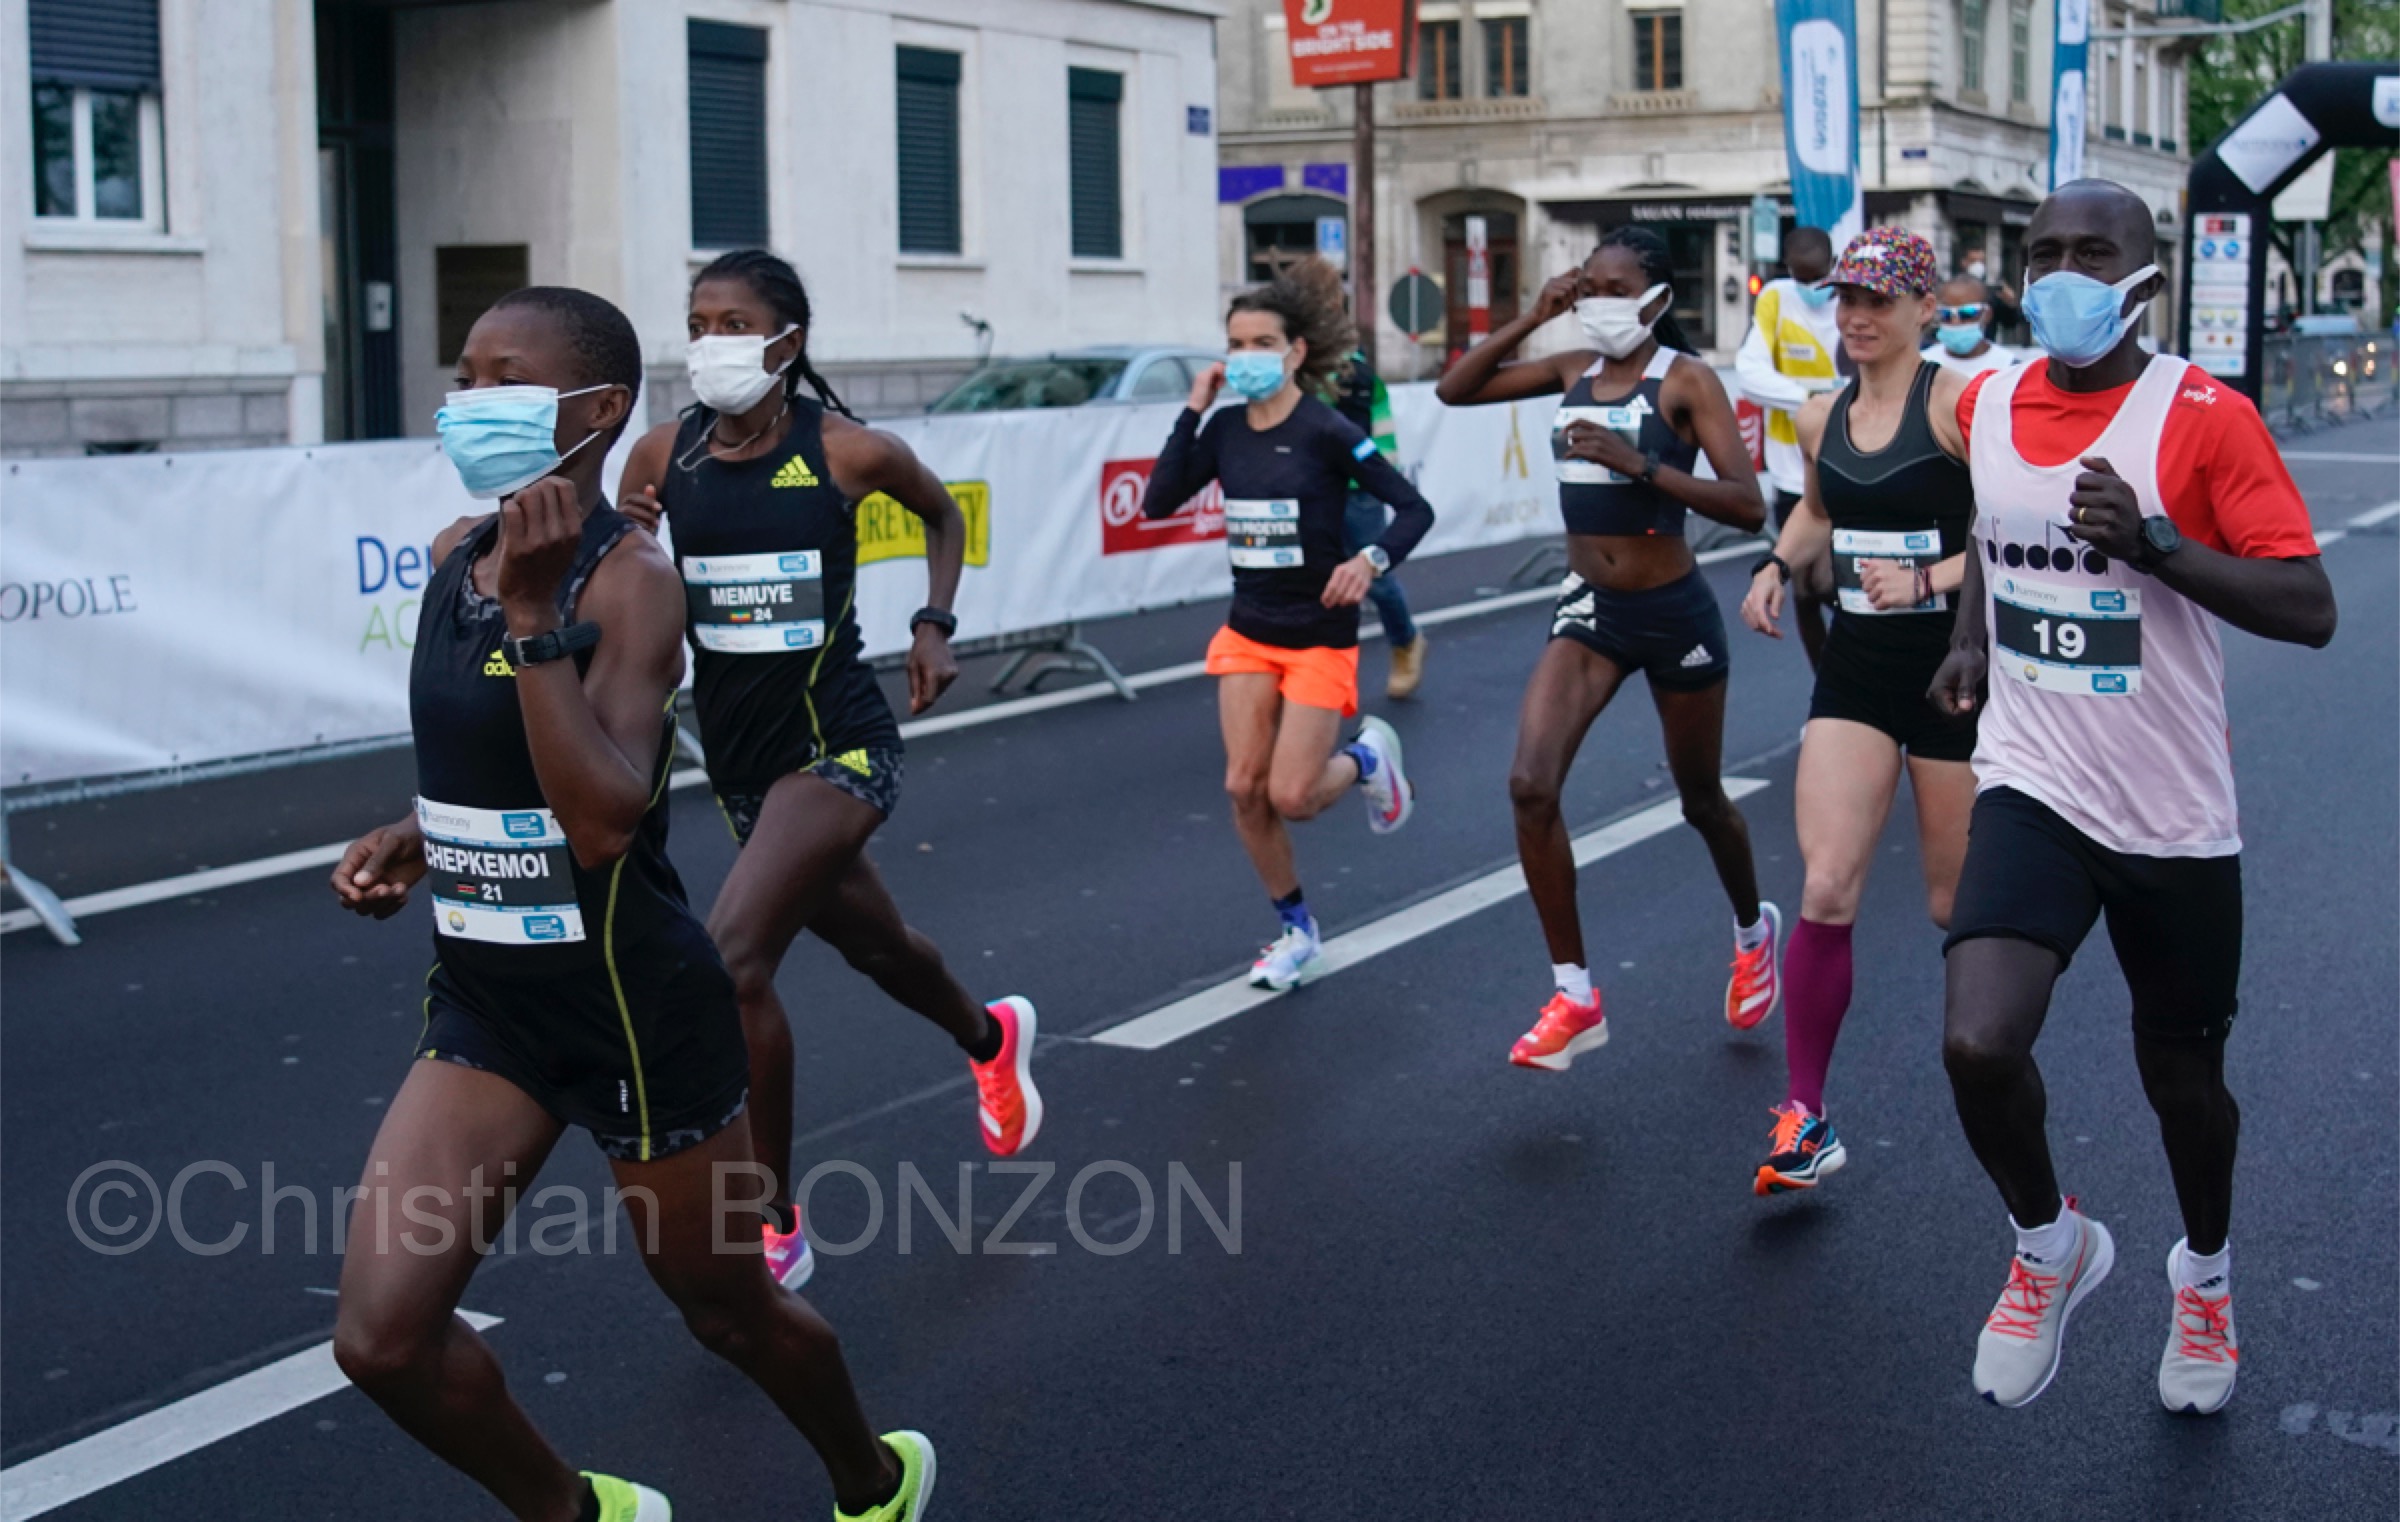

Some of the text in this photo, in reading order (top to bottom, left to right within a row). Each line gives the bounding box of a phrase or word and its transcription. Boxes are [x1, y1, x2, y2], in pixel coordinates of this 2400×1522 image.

[1340, 20, 1364, 37] THE
[1293, 29, 1393, 57] BRIGHT SIDE
[771, 475, 819, 489] adidas
[1986, 515, 2109, 576] diadora
[0, 573, 138, 622] OPOLE
[711, 583, 793, 607] MEMUYE
[2016, 584, 2058, 604] harmony
[753, 607, 773, 622] 24
[2031, 617, 2086, 659] 19
[423, 839, 550, 879] CHEPKEMOI
[481, 883, 503, 902] 21
